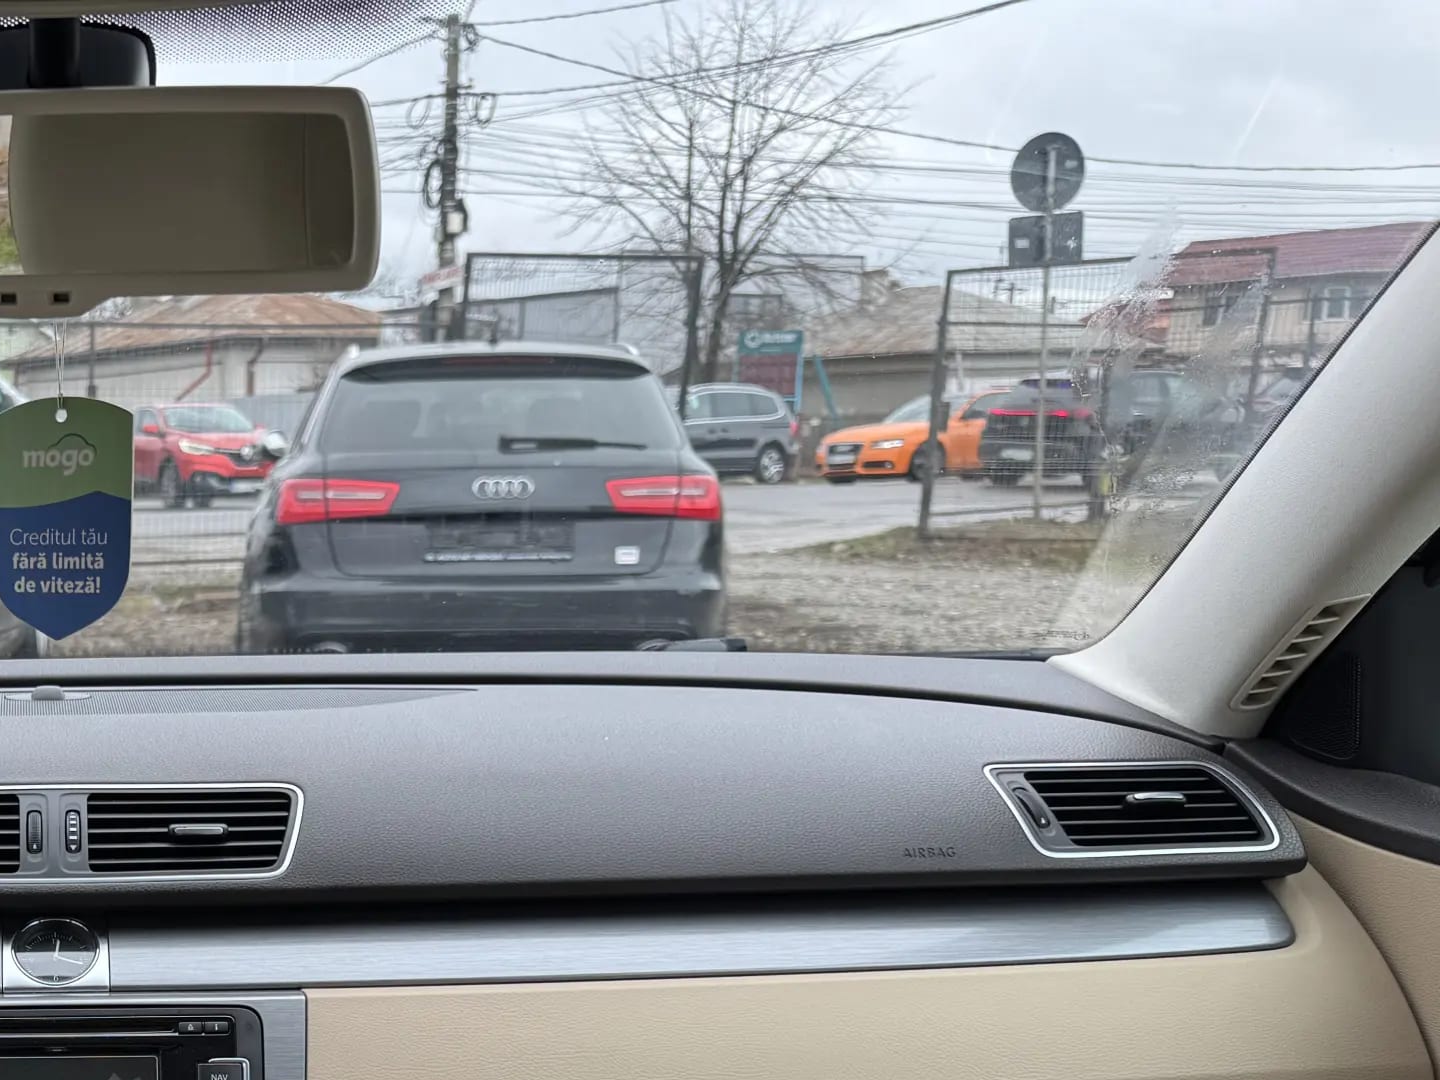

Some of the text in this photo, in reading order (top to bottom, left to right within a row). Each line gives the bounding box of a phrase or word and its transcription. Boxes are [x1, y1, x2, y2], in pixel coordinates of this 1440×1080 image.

[22, 448, 95, 477] mogo
[10, 528, 108, 546] Creditul tău
[12, 552, 104, 570] fără limită
[14, 576, 102, 594] de viteză!
[210, 1073, 228, 1080] NAV
